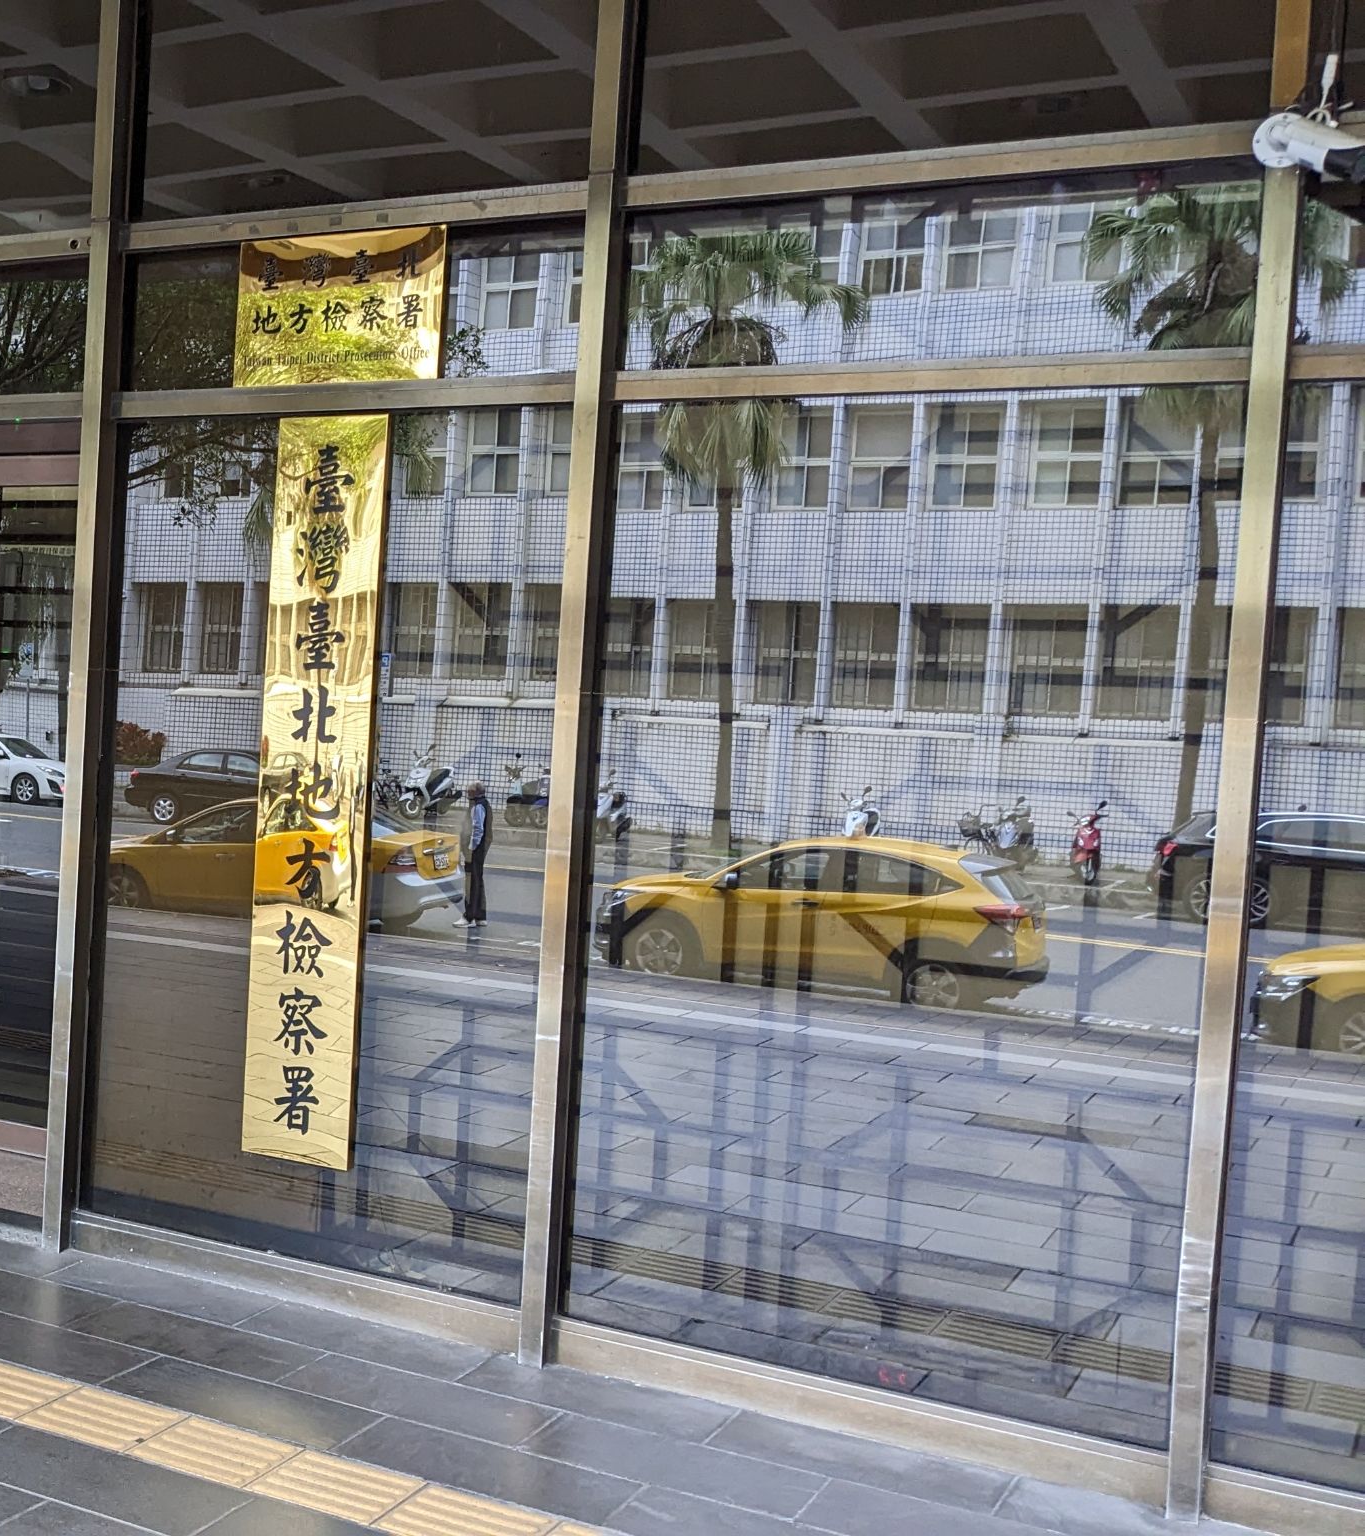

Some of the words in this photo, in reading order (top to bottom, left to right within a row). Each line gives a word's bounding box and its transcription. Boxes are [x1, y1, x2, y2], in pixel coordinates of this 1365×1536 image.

[257, 248, 423, 292] 臺灣臺北
[251, 293, 423, 335] 地方檢察署
[273, 444, 353, 1136] 臺灣臺北地方檢察署
